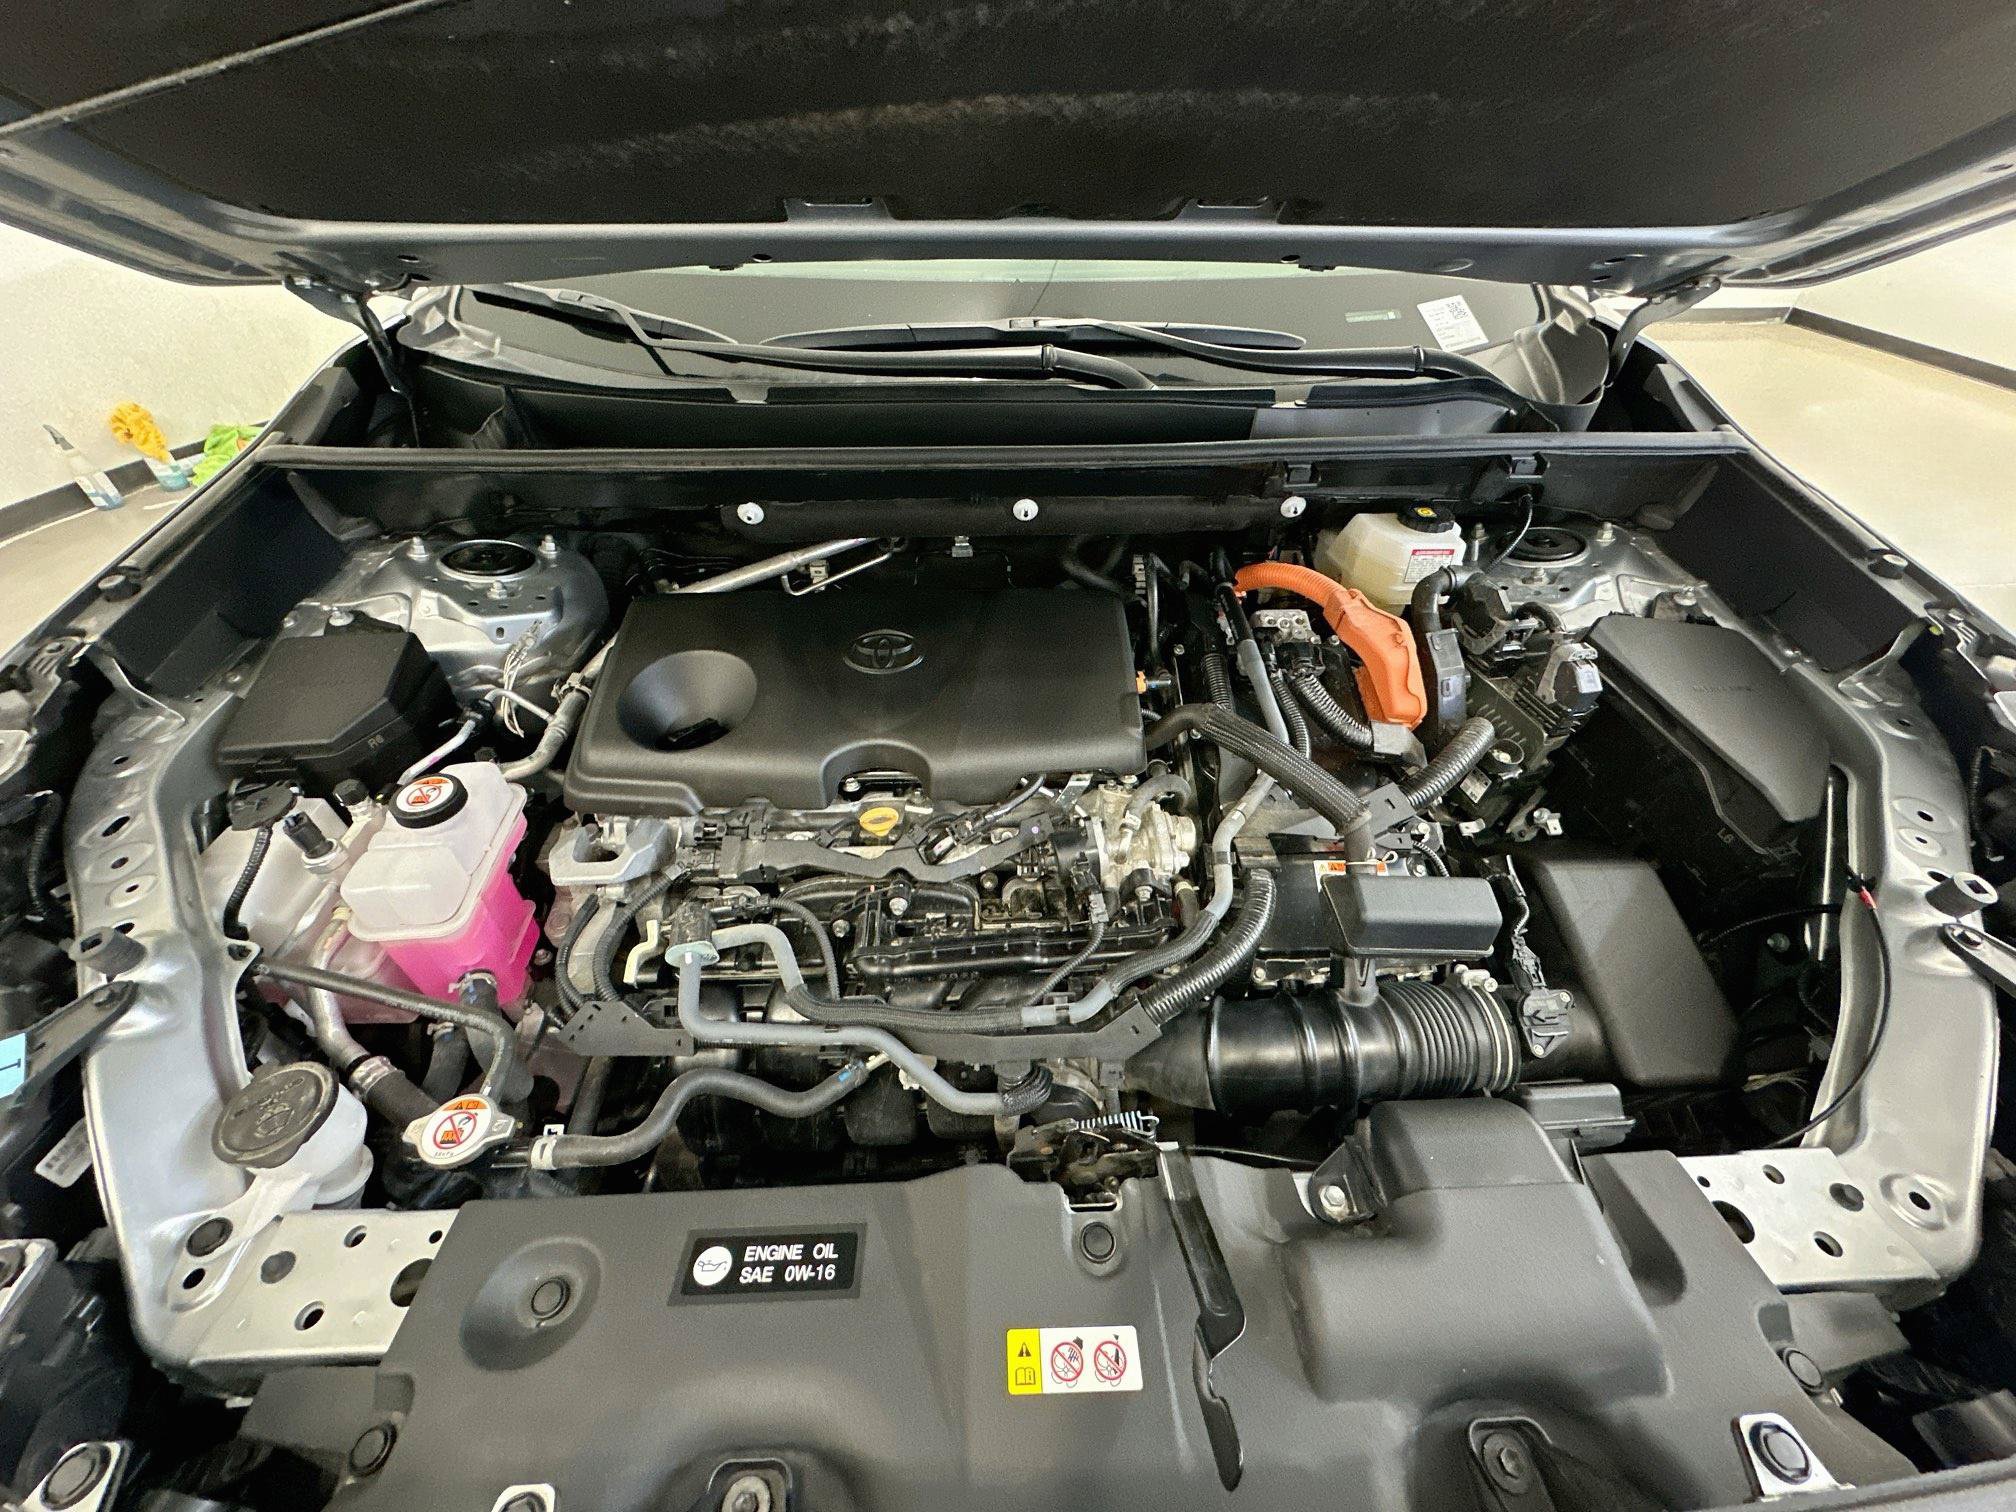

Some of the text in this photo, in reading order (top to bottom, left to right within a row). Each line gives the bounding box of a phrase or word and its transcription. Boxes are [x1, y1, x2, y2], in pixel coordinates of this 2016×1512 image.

[743, 1242, 839, 1262] ENGINE OIL
[739, 1263, 836, 1284] SAE 0W-16
